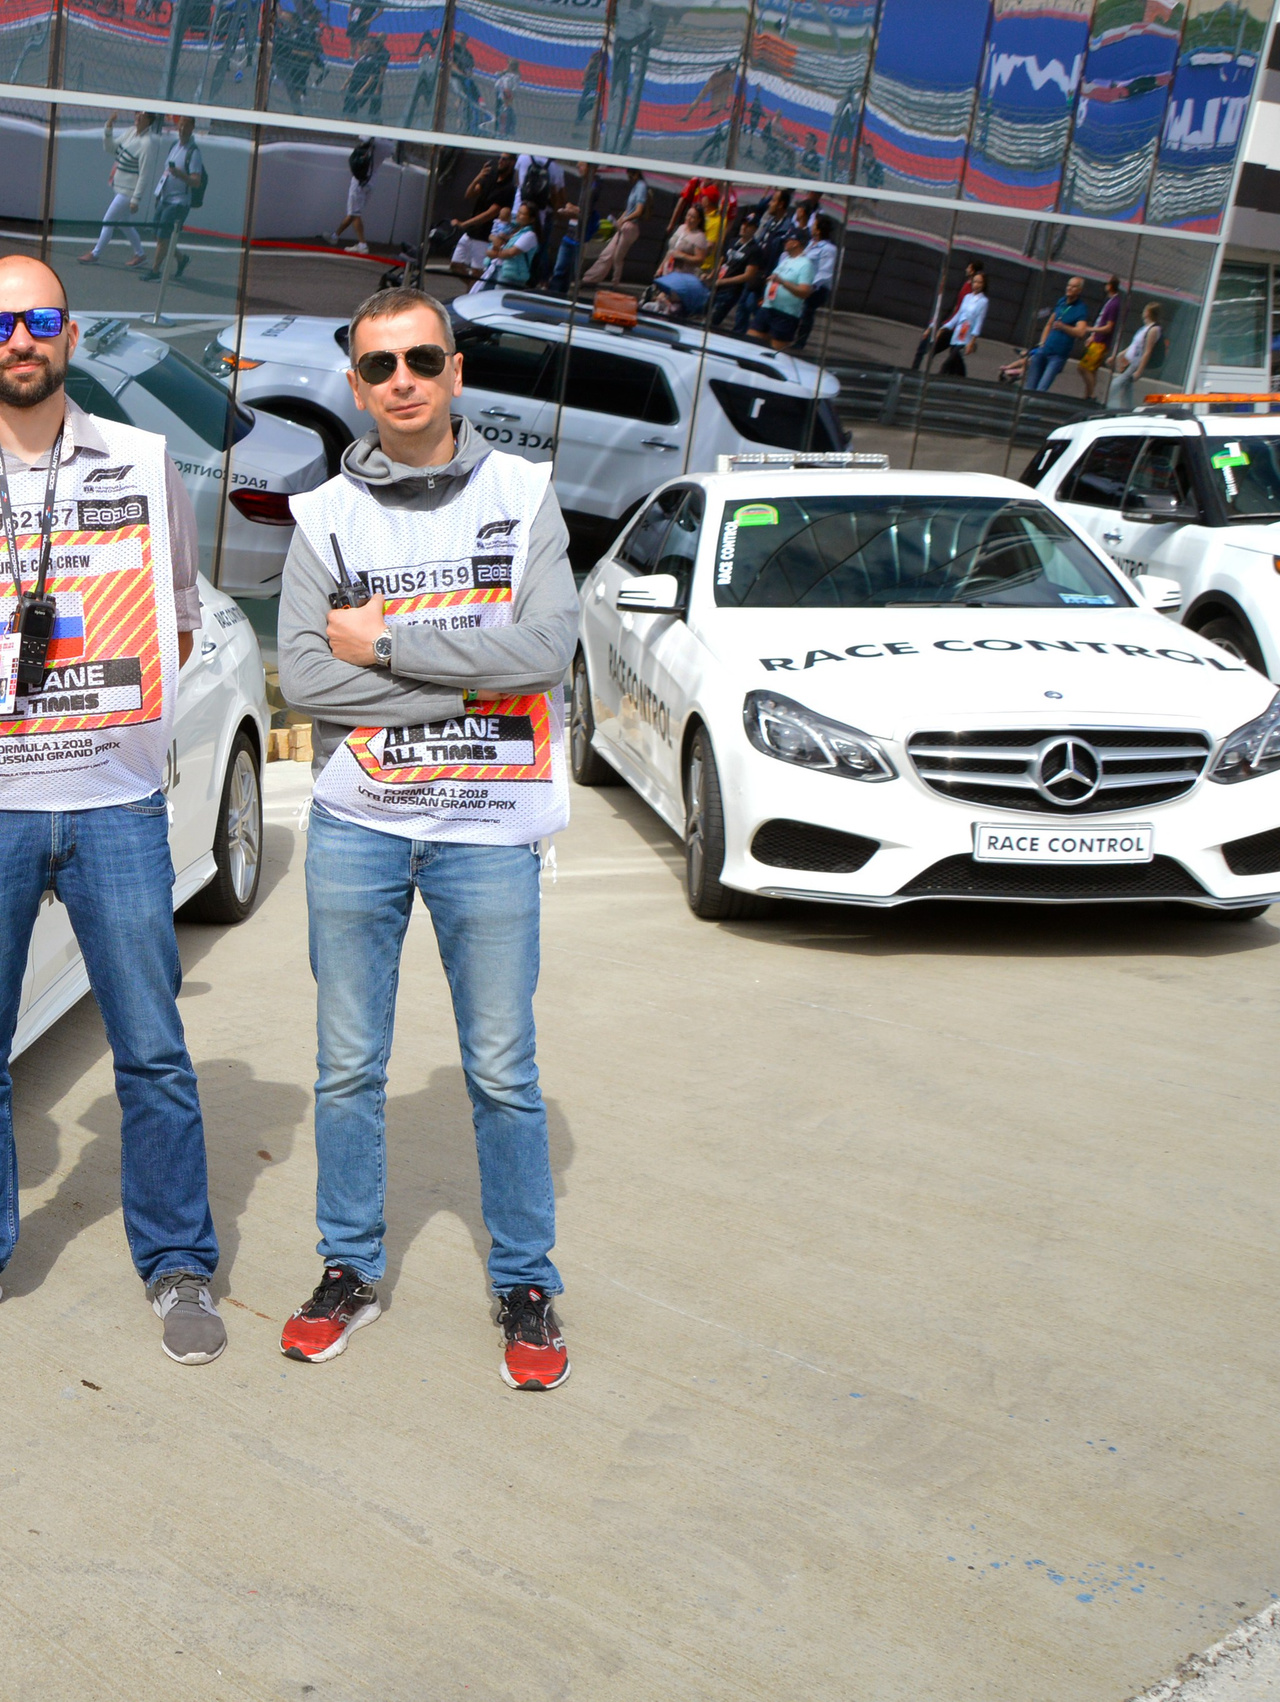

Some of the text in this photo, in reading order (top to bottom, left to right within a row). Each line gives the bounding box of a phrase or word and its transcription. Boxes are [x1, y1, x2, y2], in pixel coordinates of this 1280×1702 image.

[83, 503, 143, 525] 2018
[31, 557, 53, 573] CR
[57, 555, 91, 569] CREW
[371, 566, 470, 595] RUS2159
[451, 614, 482, 630] CREW
[758, 639, 1247, 672] RACE CONTROL
[28, 693, 100, 714] TIMES
[423, 717, 500, 739] LANE
[46, 748, 93, 761] GRAND
[95, 741, 121, 755] PRIX
[53, 741, 60, 751] 1
[62, 738, 93, 749] 2018
[382, 744, 498, 766] ALL TIMES
[382, 795, 439, 808] RUSSIAN
[440, 799, 486, 809] GRAND
[488, 800, 517, 810] PRIX
[384, 787, 489, 799] FORMULA 1 2018
[987, 835, 1145, 853] RACE CONTROL
